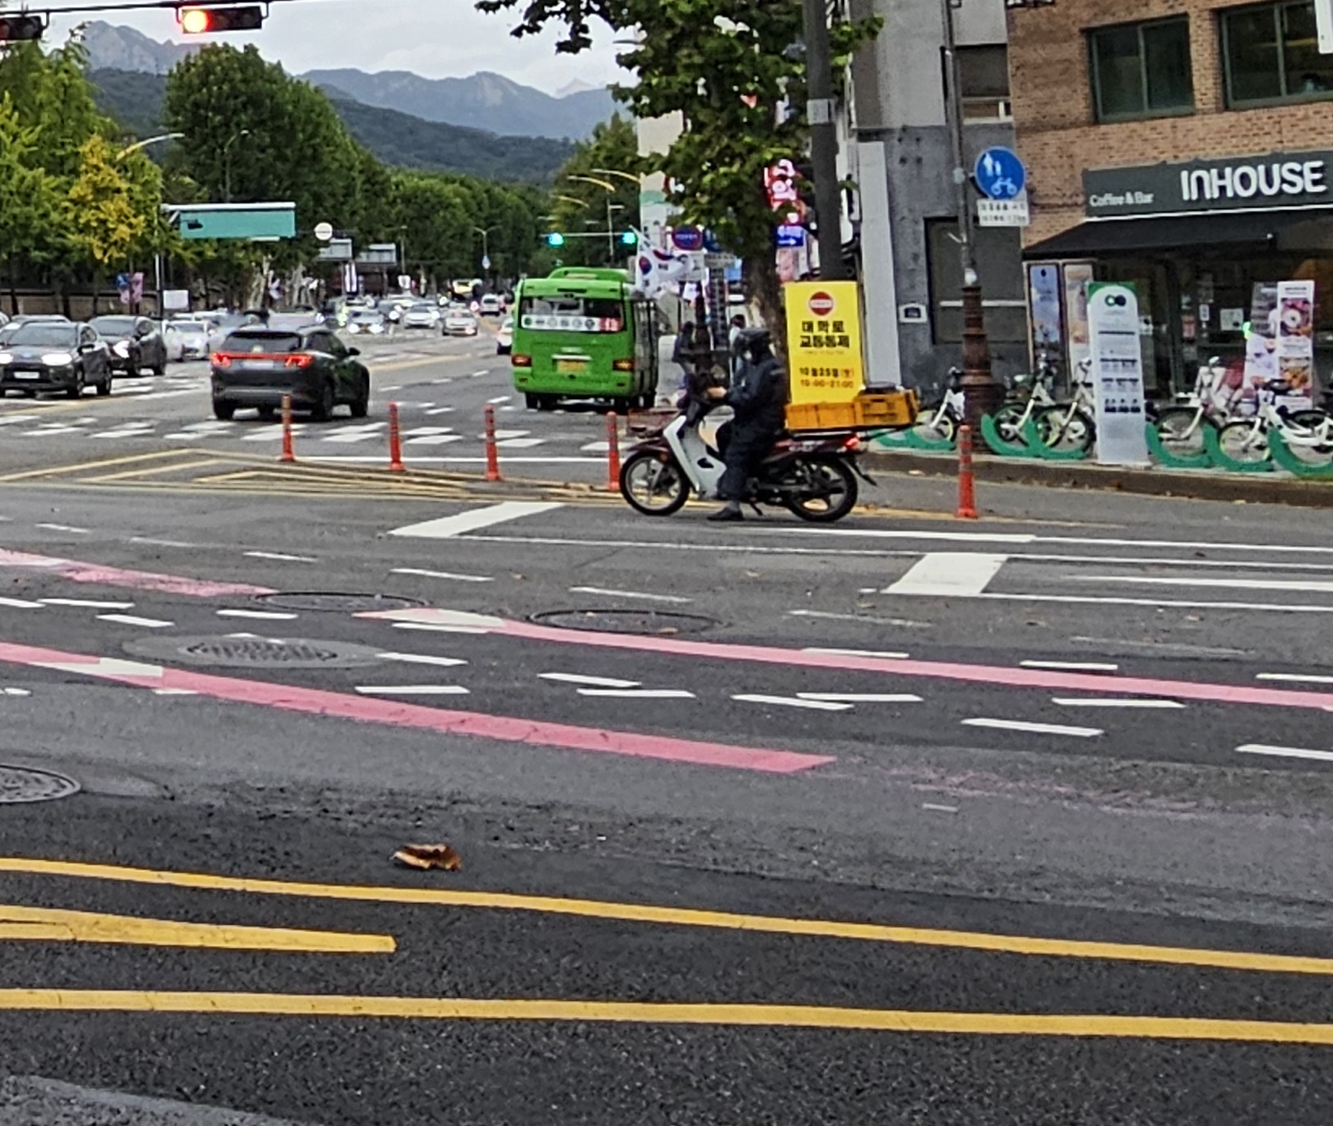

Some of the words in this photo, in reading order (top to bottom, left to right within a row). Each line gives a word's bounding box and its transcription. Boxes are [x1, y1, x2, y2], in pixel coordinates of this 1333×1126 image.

[1089, 193, 1124, 207] Coffee
[1134, 191, 1154, 205] Bar
[801, 320, 844, 335] 대학로
